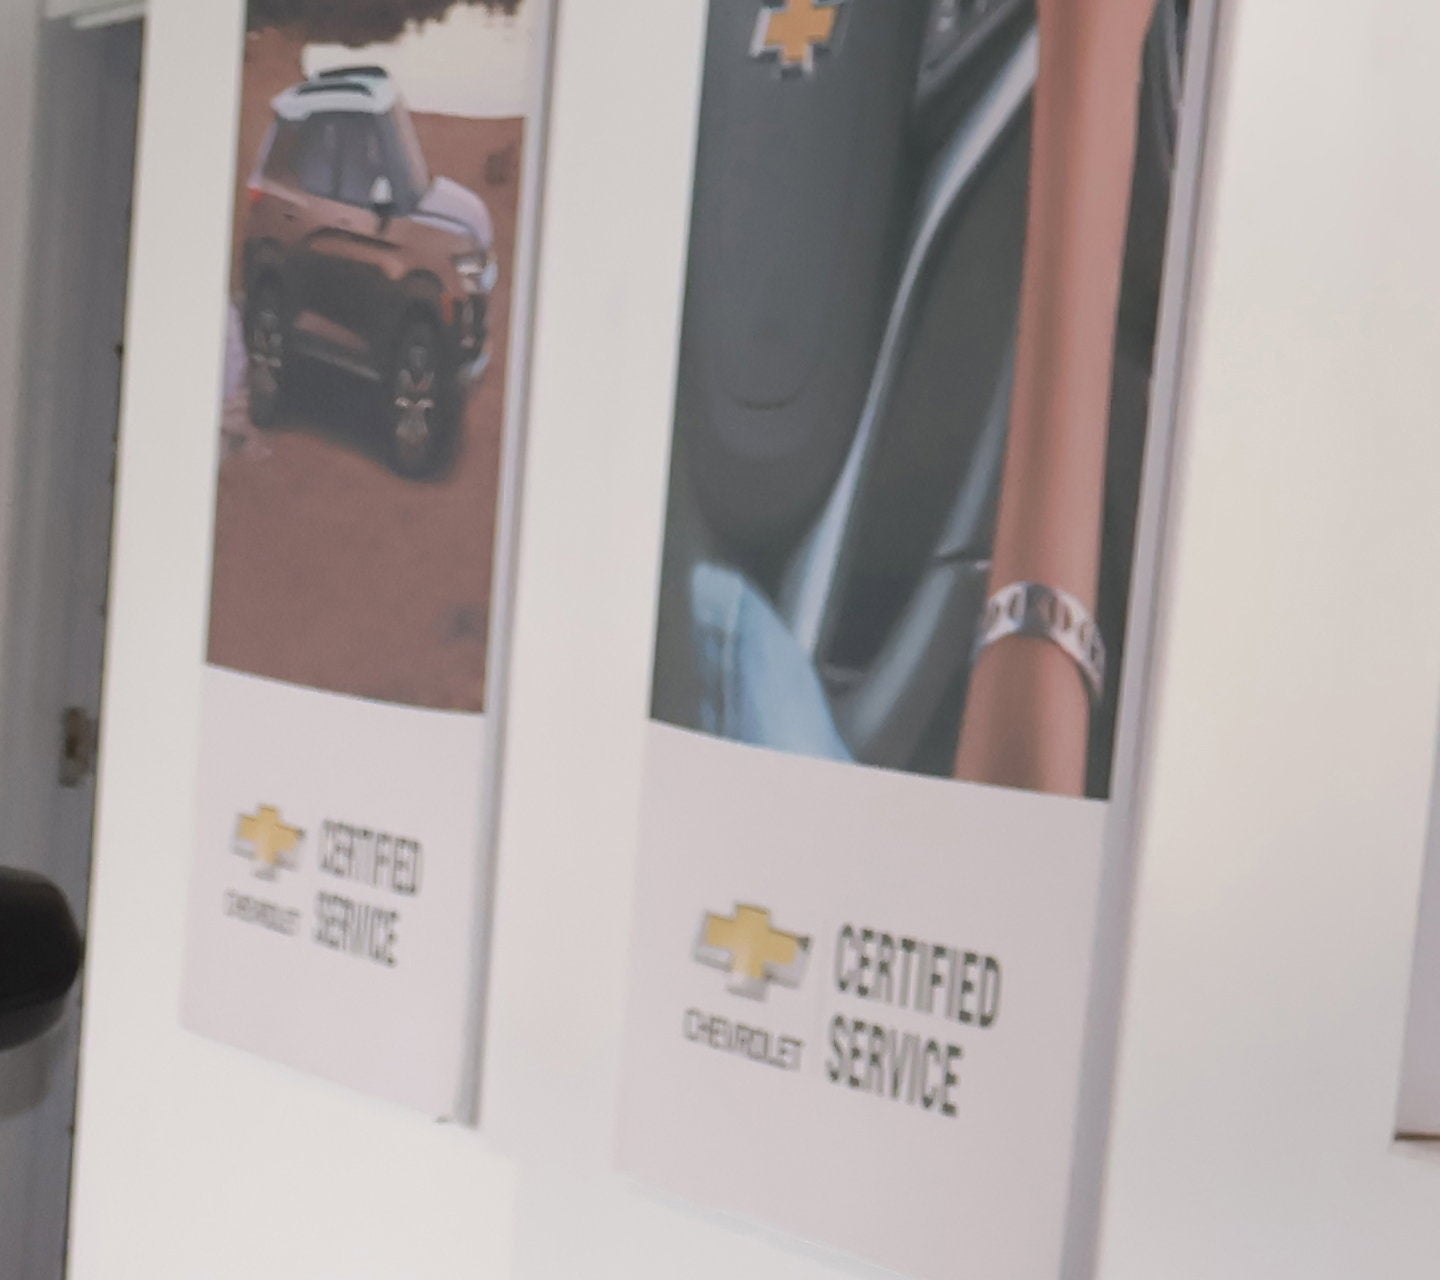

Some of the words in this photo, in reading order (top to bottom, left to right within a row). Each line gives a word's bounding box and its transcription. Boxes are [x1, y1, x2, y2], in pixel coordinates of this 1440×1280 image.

[318, 818, 424, 898] CERTIFIED
[312, 890, 400, 968] SERVICE
[833, 921, 1003, 1031] CERTIFIED
[682, 1006, 805, 1072] CHEVROLET
[825, 1011, 965, 1118] SERVICE
